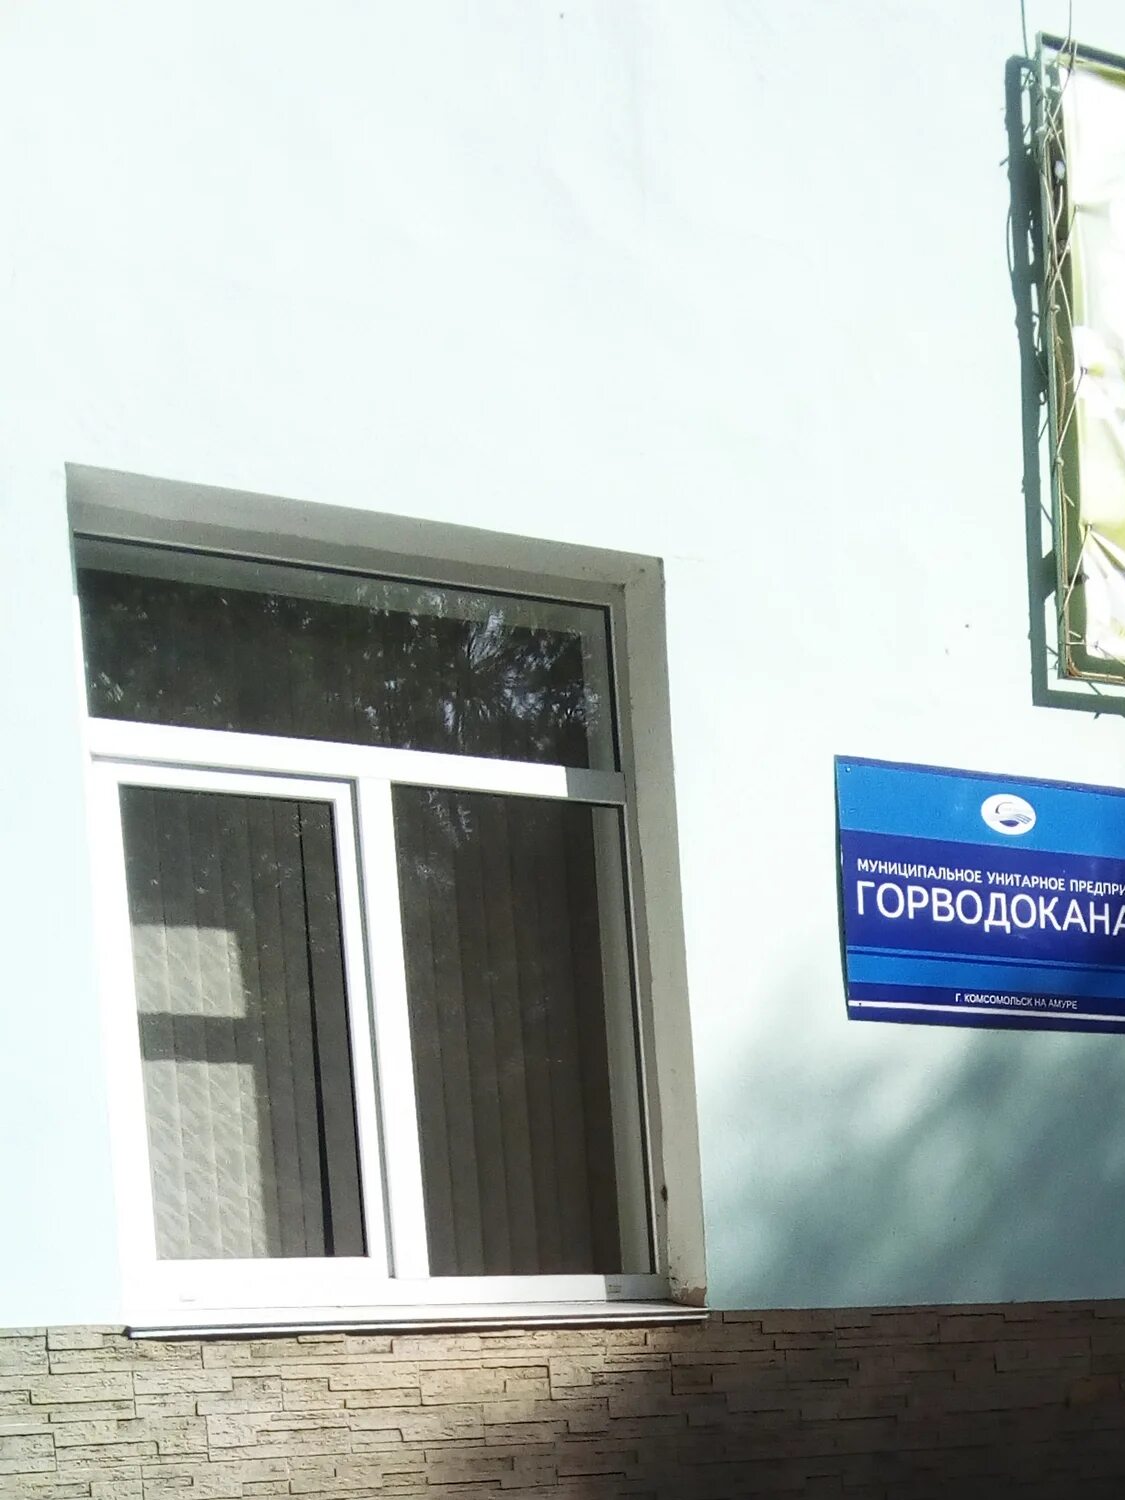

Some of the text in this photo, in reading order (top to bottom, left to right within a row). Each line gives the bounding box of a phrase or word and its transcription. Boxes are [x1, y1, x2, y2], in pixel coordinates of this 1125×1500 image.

[856, 857, 983, 884] МУНИЦИПАЛЬНОЕ
[987, 872, 1066, 892] УНИТАРНОЕ
[964, 993, 1033, 1007] КОМСОМОЛЬСК
[1034, 999, 1047, 1007] НА
[1048, 1000, 1078, 1010] АМУРЕ
